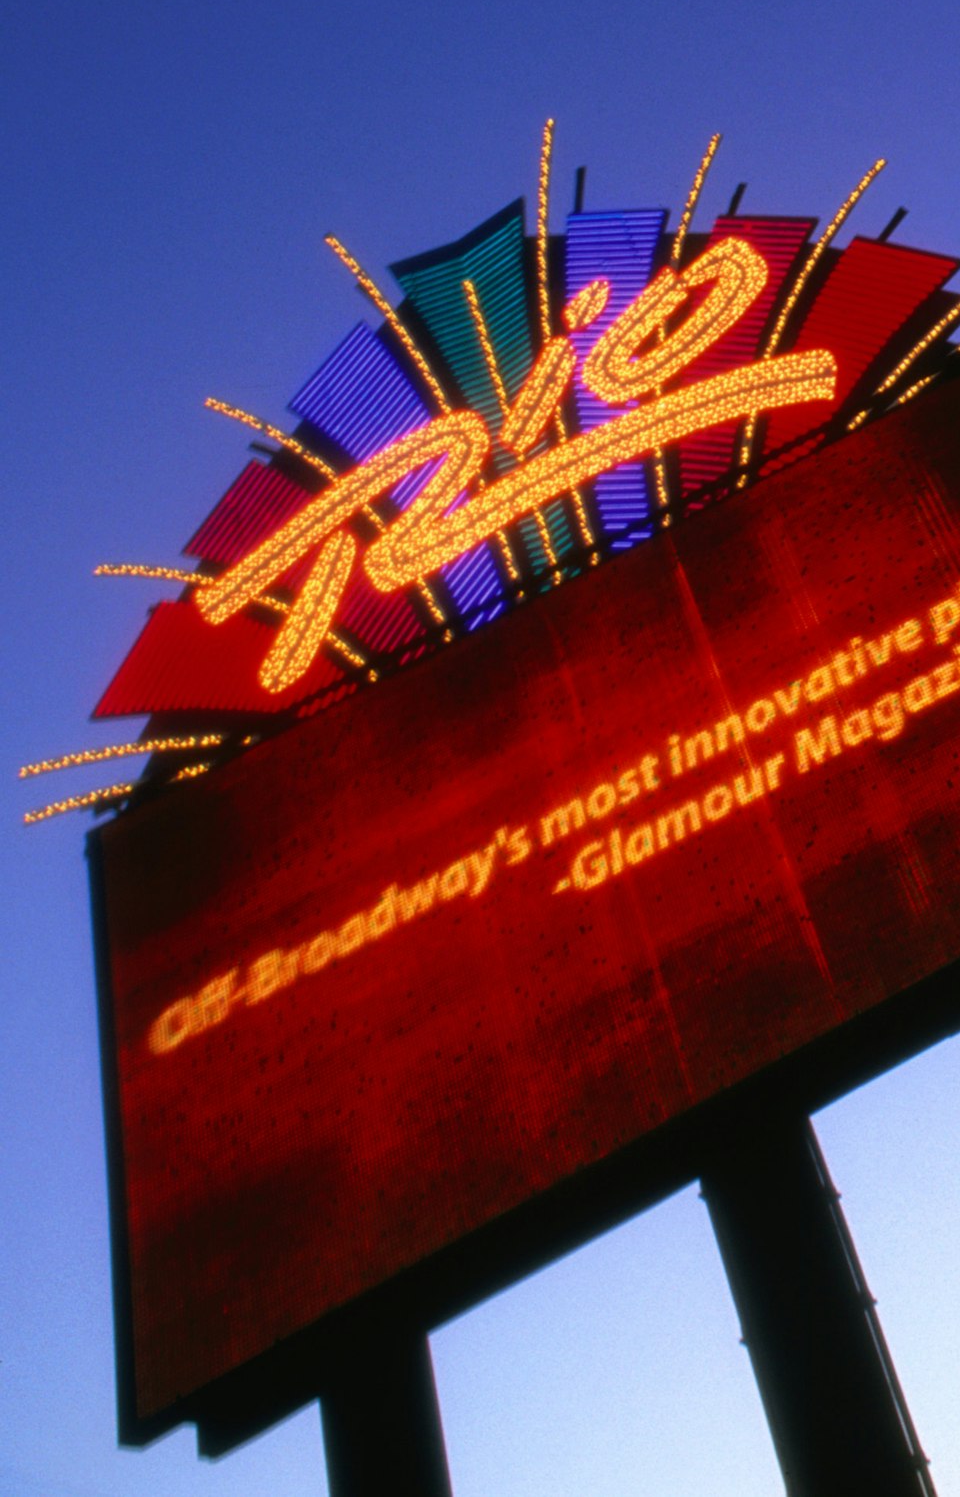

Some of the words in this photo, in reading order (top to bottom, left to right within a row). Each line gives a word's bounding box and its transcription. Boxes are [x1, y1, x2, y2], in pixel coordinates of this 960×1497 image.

[195, 237, 839, 694] Rio
[147, 825, 532, 1055] Off-Broadway's
[539, 754, 660, 847] most
[668, 635, 924, 777] innovative
